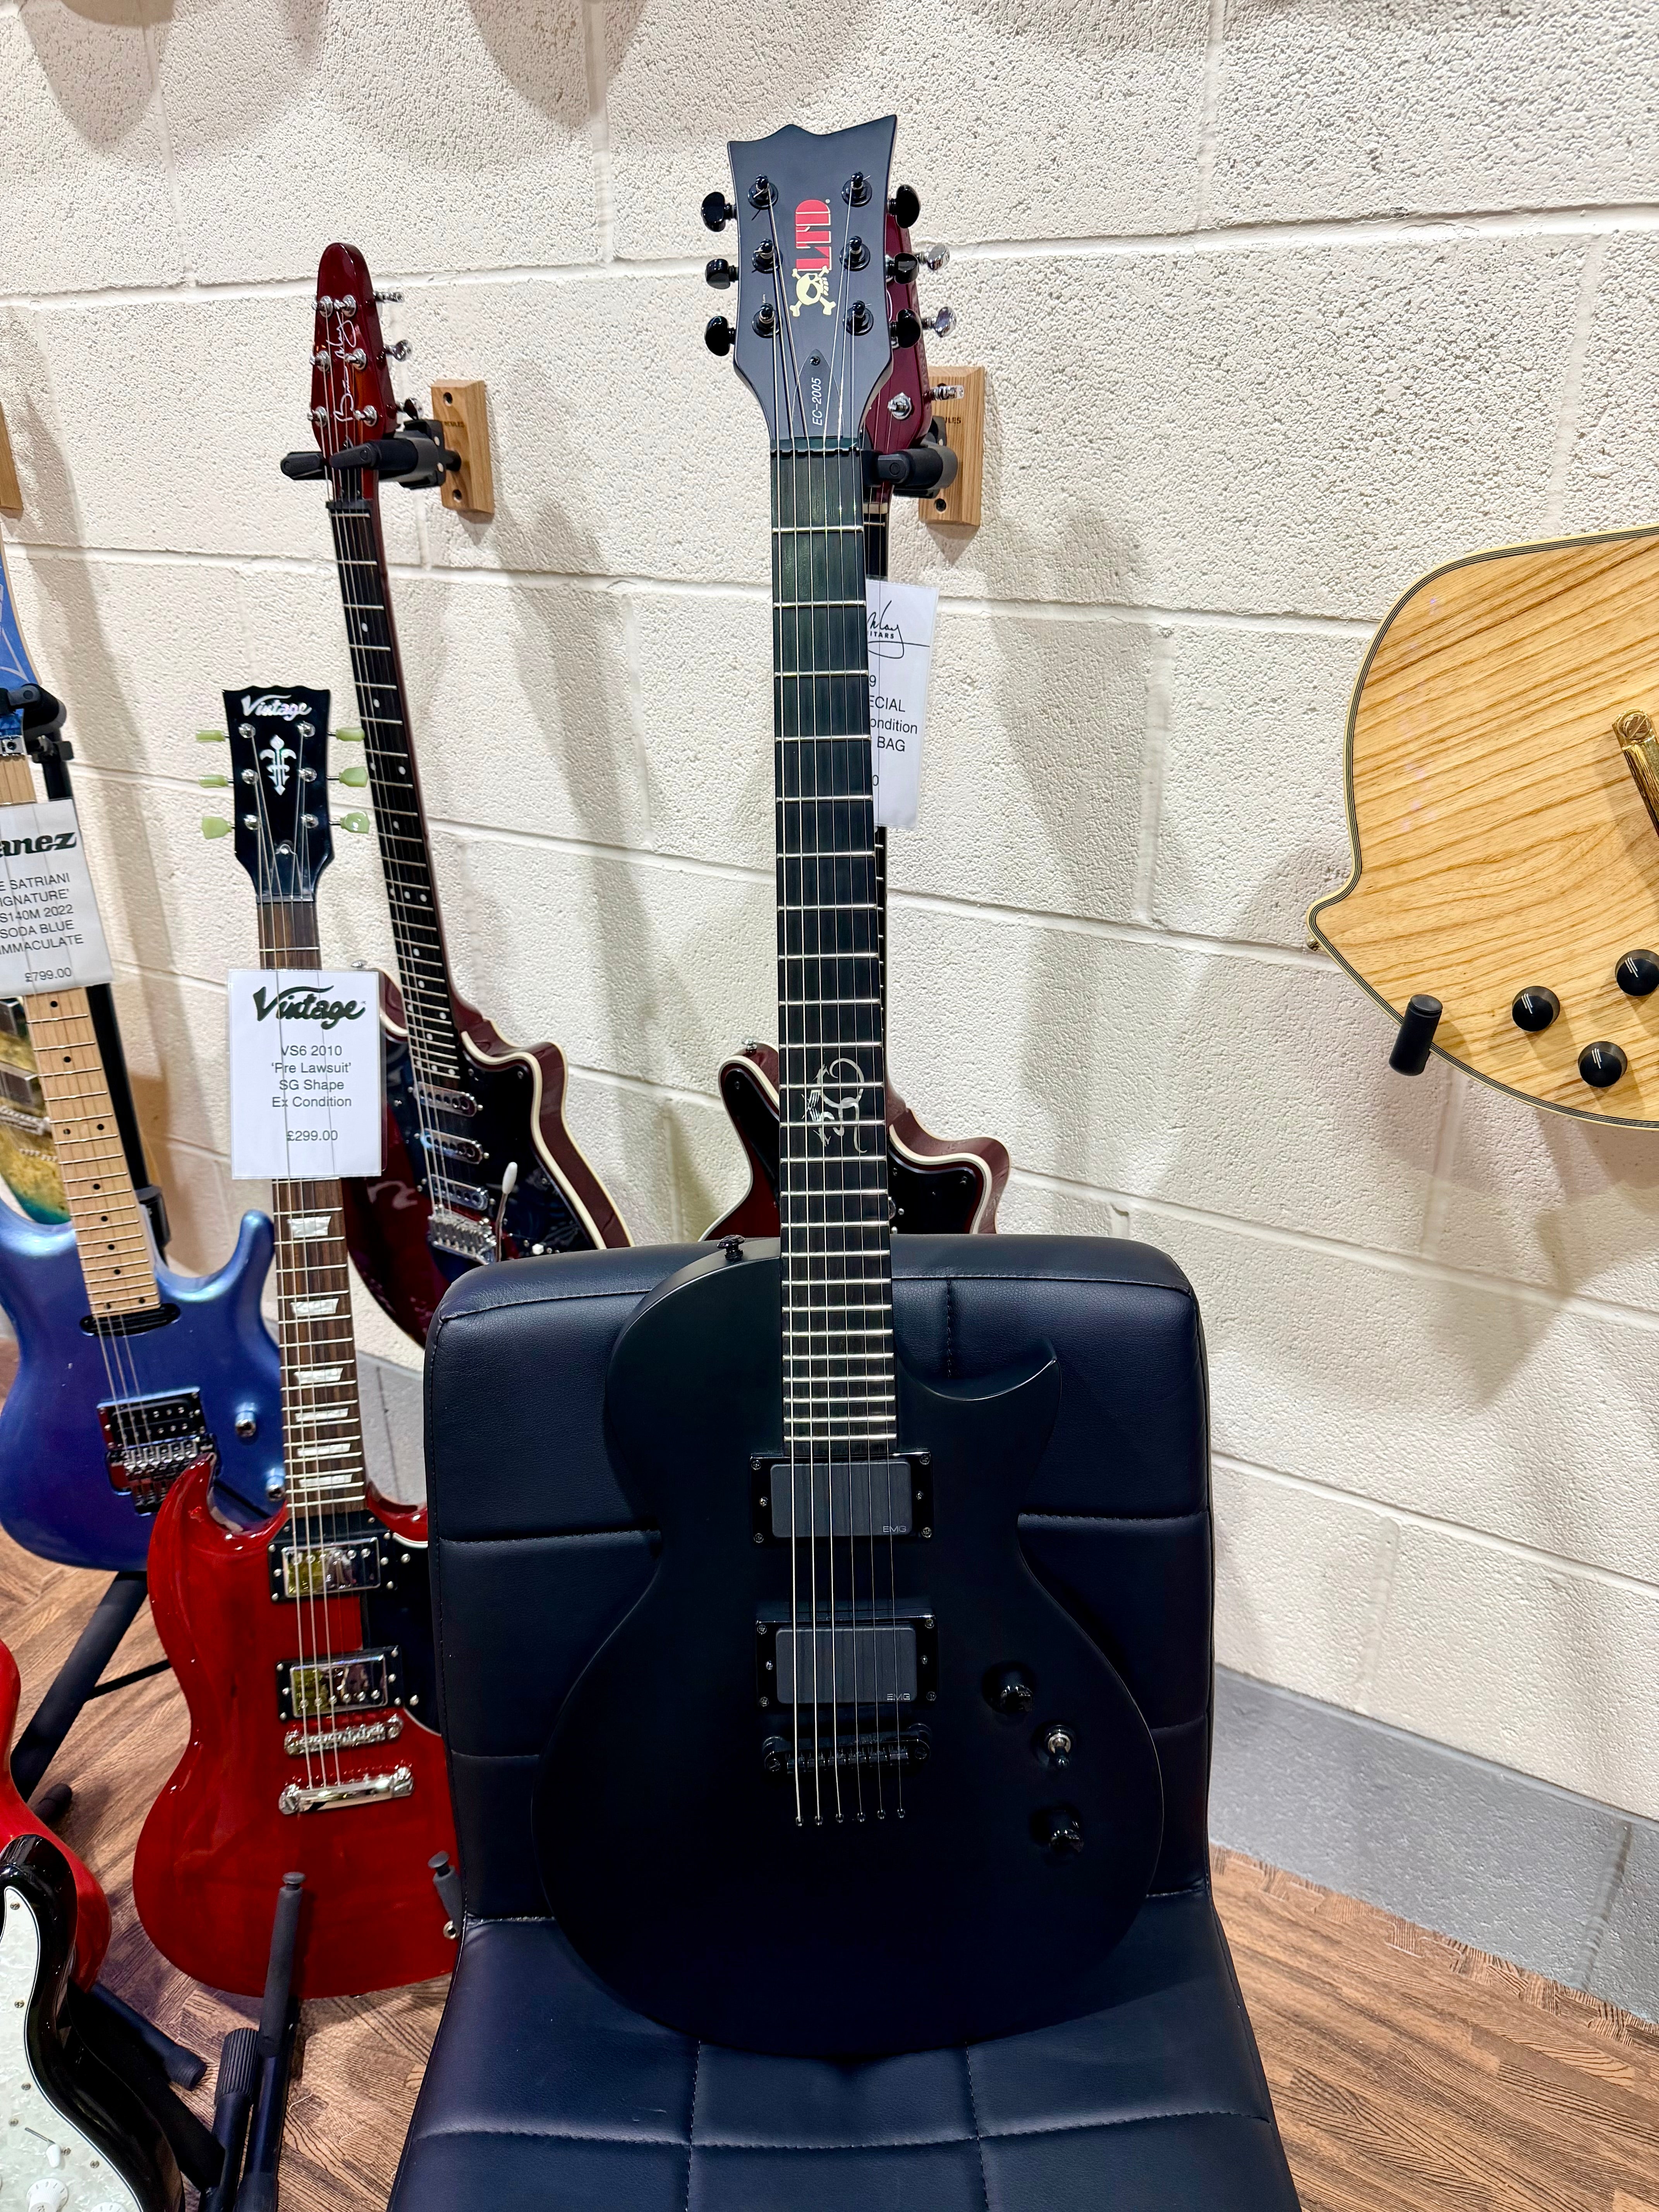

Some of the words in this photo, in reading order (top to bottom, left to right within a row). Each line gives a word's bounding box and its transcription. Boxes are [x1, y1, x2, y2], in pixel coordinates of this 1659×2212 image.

[811, 377, 823, 426] EC-2005
[867, 631, 894, 639] ITARS
[240, 694, 313, 721] Vintage
[869, 695, 905, 712] ECIAL
[870, 718, 917, 734] ondition
[877, 736, 905, 752] BAG
[0, 832, 77, 858] anez
[10, 872, 70, 890] SATRIANI
[0, 908, 41, 923] S140M
[44, 904, 74, 917] 2022
[0, 926, 37, 939] SODA
[39, 920, 75, 933] BLUE
[25, 967, 72, 982] £799.00
[253, 985, 366, 1030] Vintage
[281, 1045, 307, 1056] VS6
[311, 1045, 342, 1056] 2010
[279, 1079, 299, 1090] SG
[303, 1079, 344, 1092] Shape
[272, 1097, 288, 1107] Ex
[292, 1096, 352, 1107] Condition
[287, 1130, 338, 1141] £299.00
